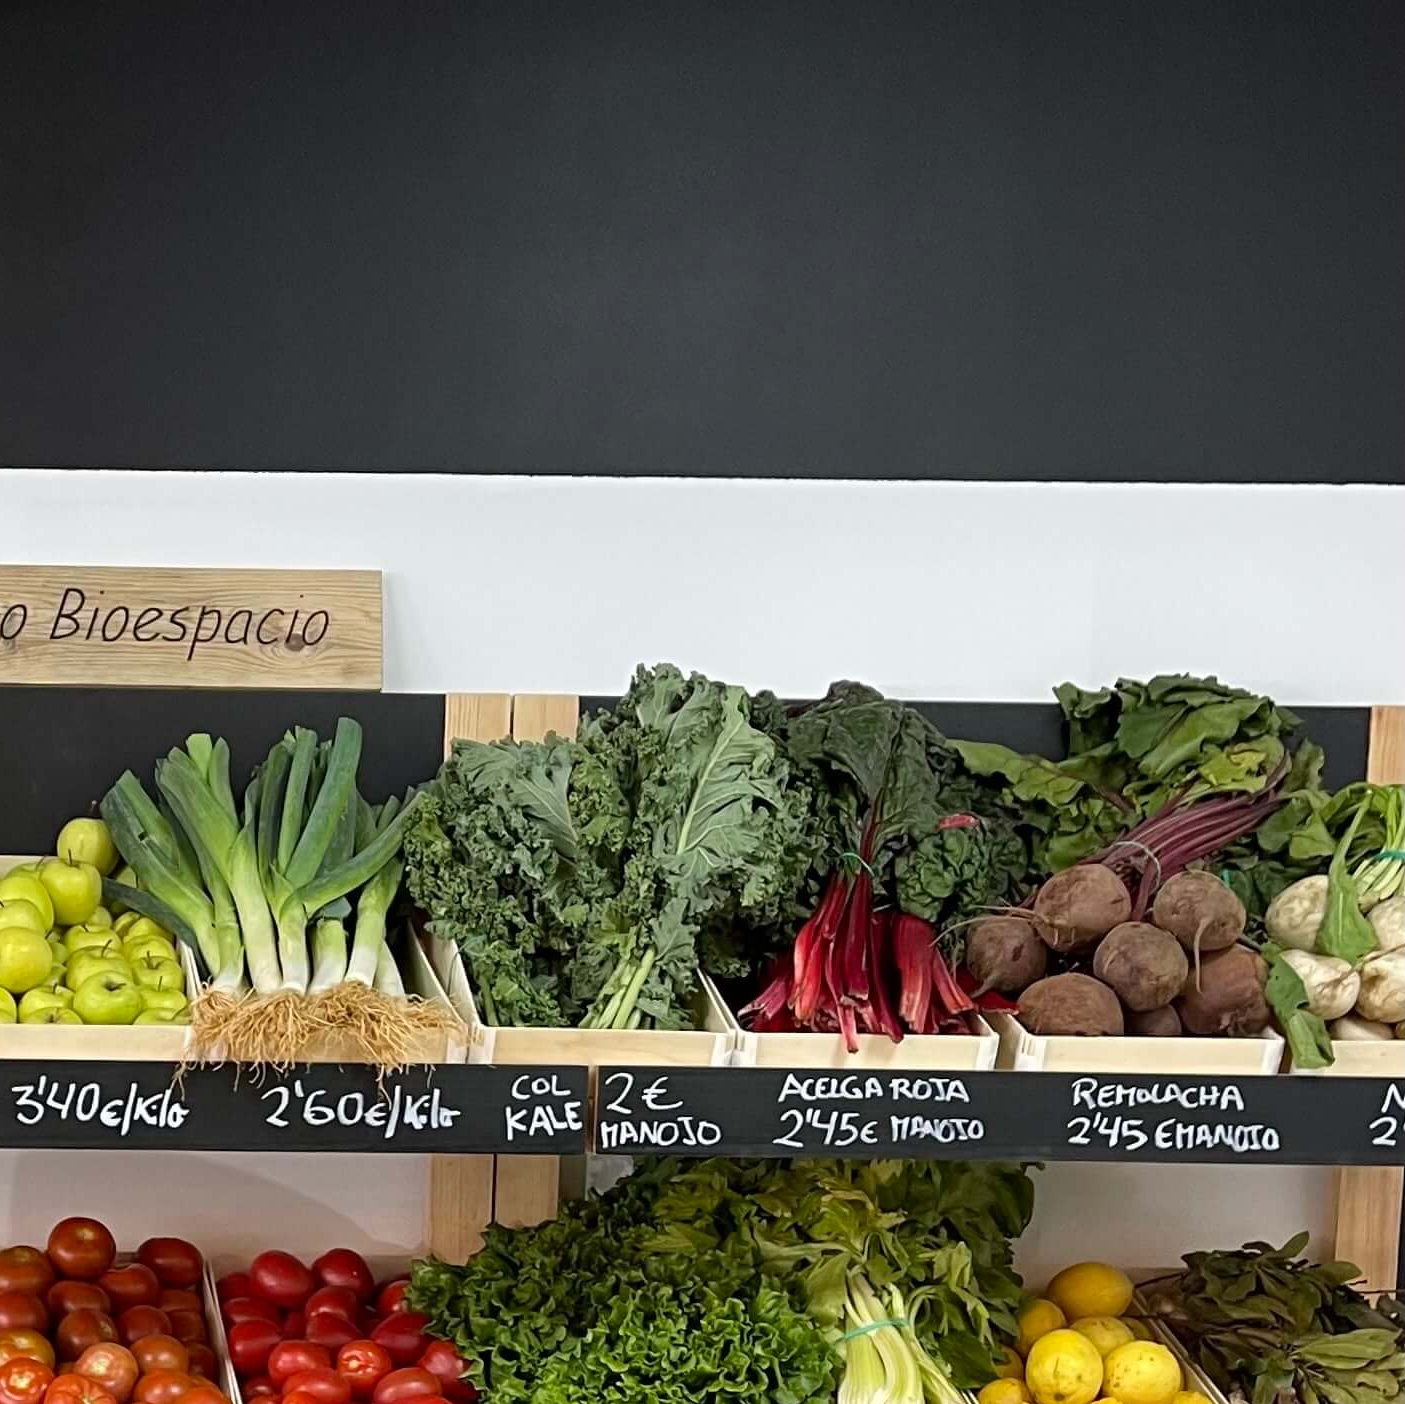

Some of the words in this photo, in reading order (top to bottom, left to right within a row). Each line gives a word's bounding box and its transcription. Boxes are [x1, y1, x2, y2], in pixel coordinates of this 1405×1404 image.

[46, 588, 331, 662] Bioespacio
[511, 1074, 571, 1100] COL
[777, 1073, 884, 1103] ACELGA
[888, 1077, 970, 1103] ROJA
[11, 1075, 190, 1136] 3'40€/Kilo
[261, 1079, 461, 1139] 2'60€/Kilo
[505, 1101, 583, 1141] KALE
[600, 1116, 721, 1149] MANOJO
[890, 1115, 984, 1143] MANOJO
